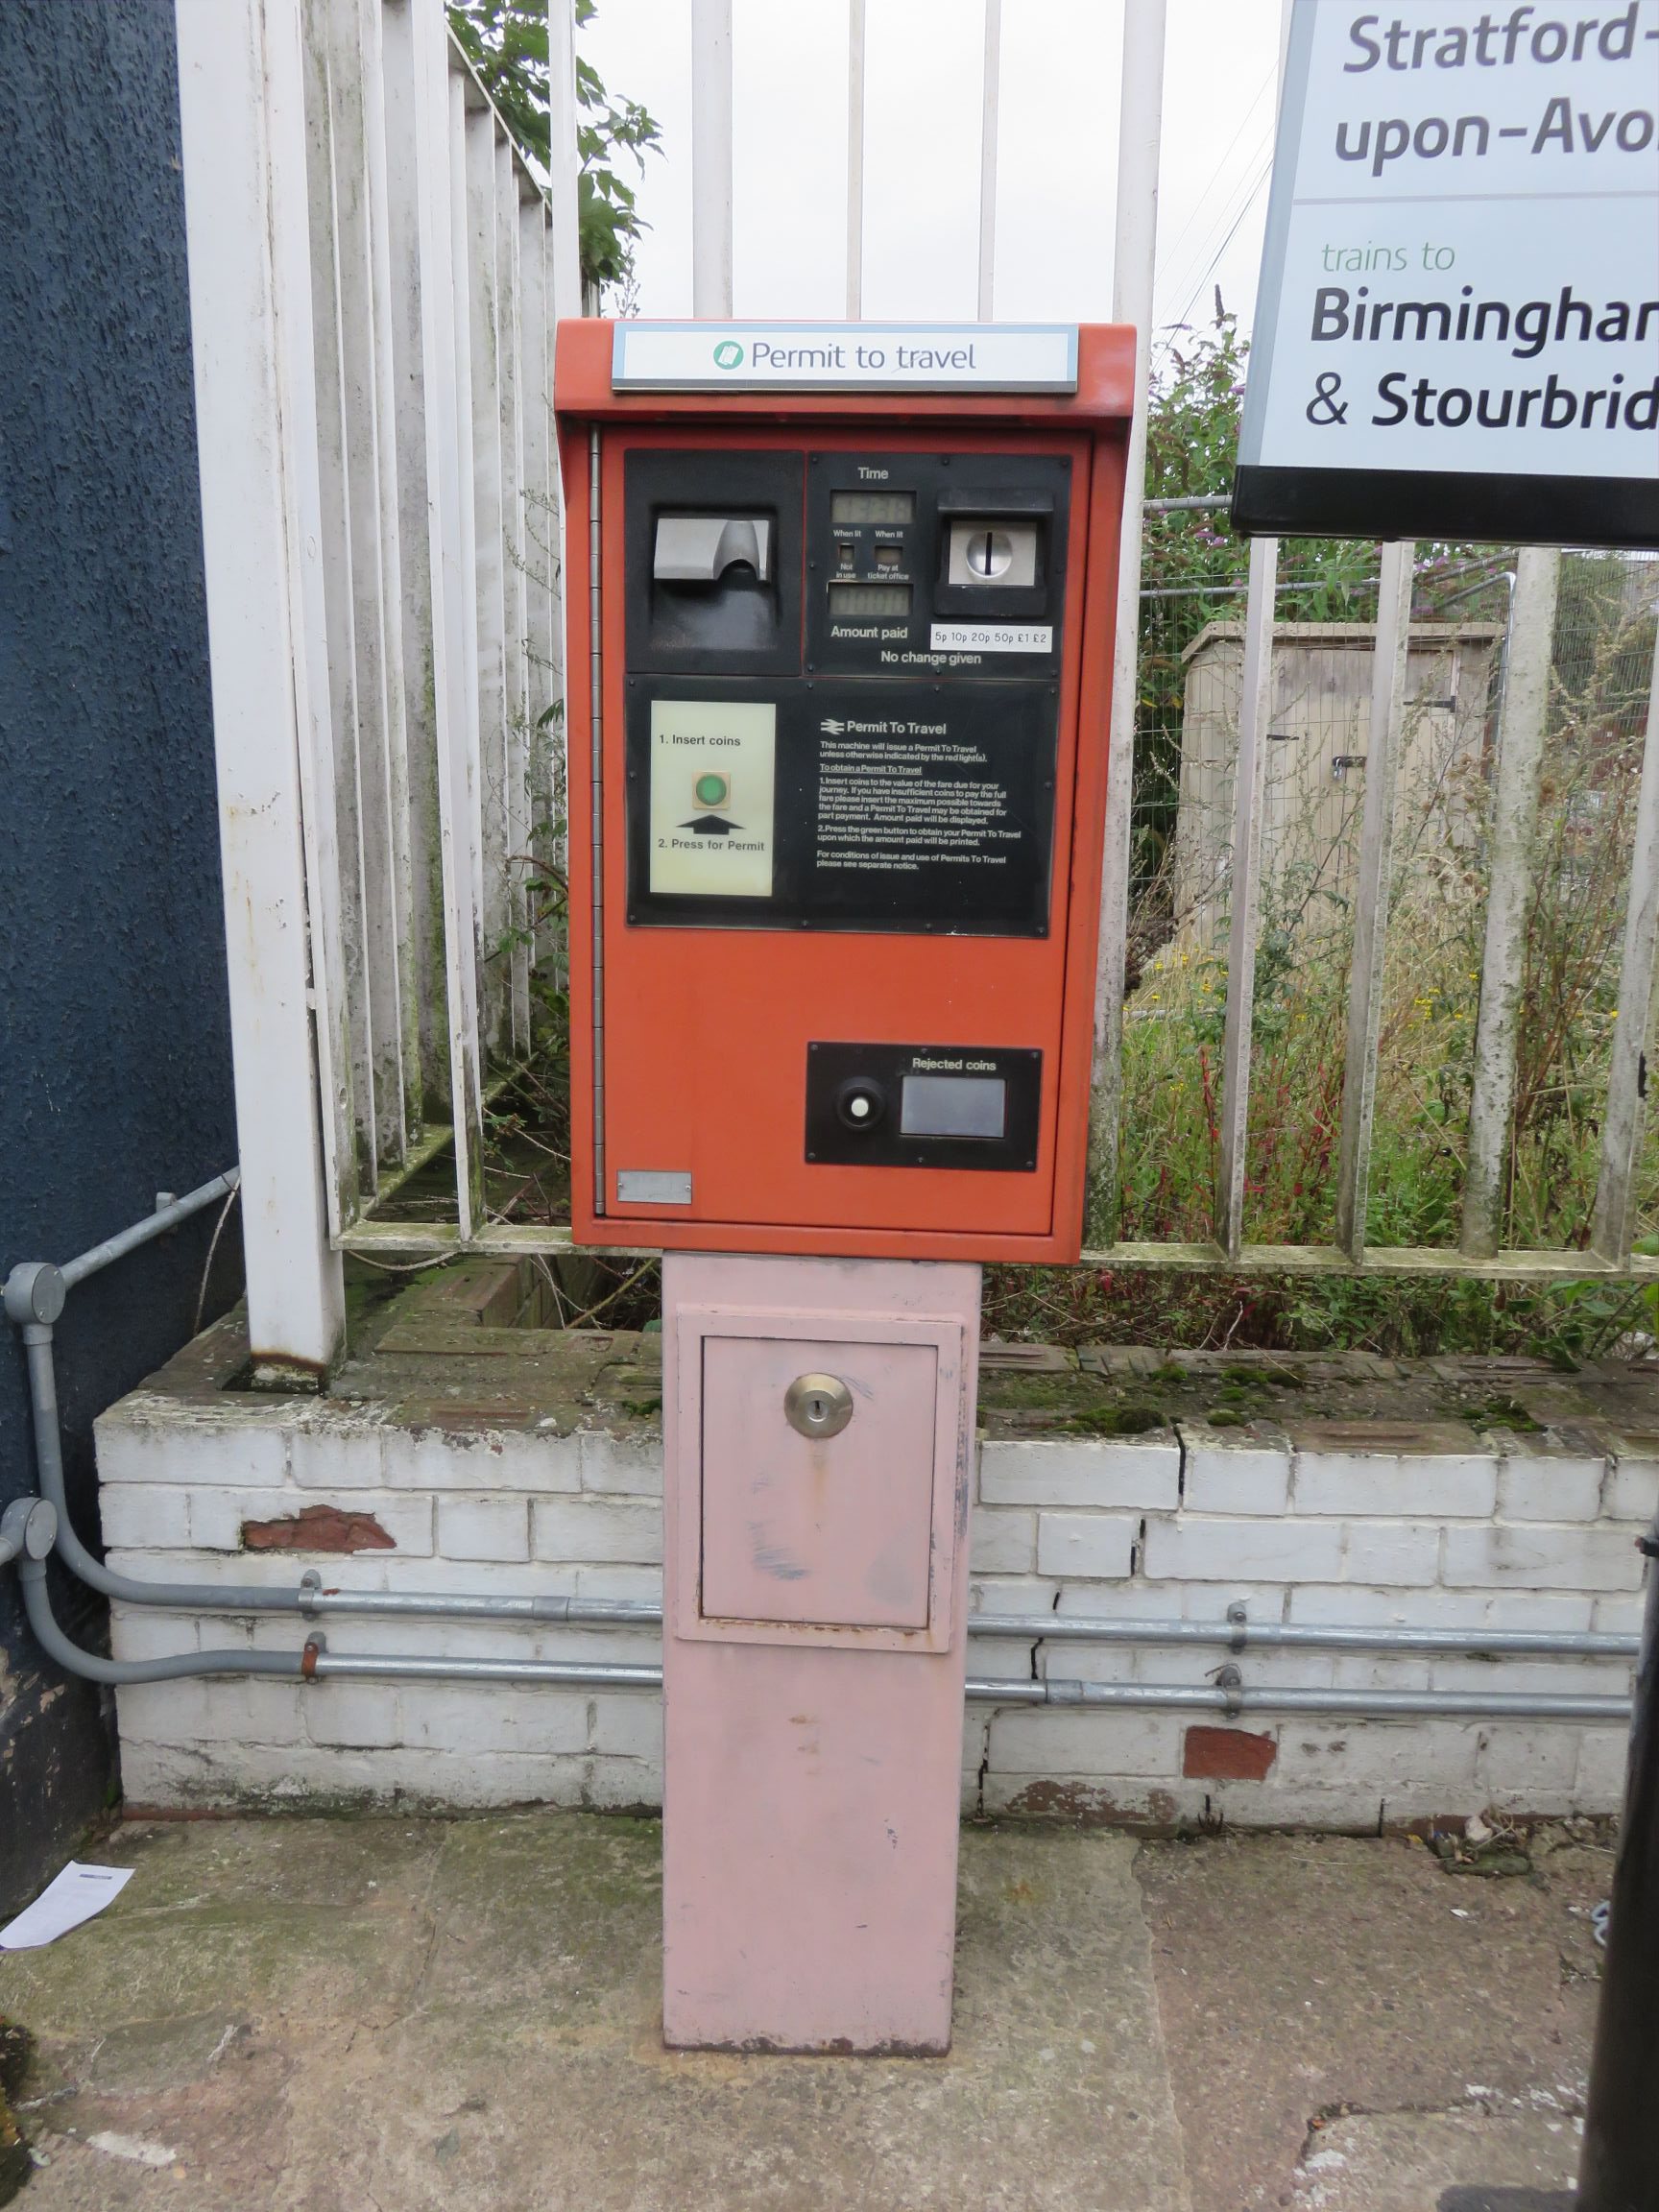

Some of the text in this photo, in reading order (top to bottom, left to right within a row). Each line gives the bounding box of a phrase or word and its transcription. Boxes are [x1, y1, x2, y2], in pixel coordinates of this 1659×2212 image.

[1335, 97, 1659, 178] upon-Avo
[1321, 240, 1455, 272] trains to
[752, 342, 976, 370] Permit to travel
[1306, 372, 1349, 425] &
[857, 467, 889, 480] Time
[832, 529, 854, 538] When
[875, 530, 895, 539] When
[878, 564, 890, 572] Pay
[888, 572, 909, 581] office
[830, 626, 908, 640] Amount paid
[935, 631, 1046, 643] 5p 10p 20p 50p £1 £2
[880, 651, 982, 667] No change given
[847, 720, 947, 734] Permit To Travel
[660, 734, 741, 747] 1. Insert coins
[872, 742, 885, 751] will
[845, 751, 884, 759] otherwise
[921, 753, 930, 761] by
[959, 755, 987, 763] light(s).
[861, 764, 886, 773] Permit
[887, 765, 898, 774] To
[819, 786, 850, 795] journey.
[891, 787, 934, 796] insufficient
[834, 795, 861, 804] please
[936, 798, 970, 806] possible
[970, 799, 1001, 807] towards
[907, 805, 931, 814] Travel
[931, 807, 949, 816] may
[960, 807, 995, 816] obtained
[818, 812, 834, 821] part
[835, 813, 871, 822] payment.
[873, 813, 903, 822] Amount
[905, 814, 922, 823] paid
[950, 816, 989, 825] displayed.
[847, 825, 860, 833] the
[918, 827, 943, 835] obtain
[943, 829, 960, 837] your
[961, 829, 987, 837] Permit
[987, 830, 998, 838] To
[998, 830, 1022, 838] Travel
[658, 838, 765, 852] 2. Press for Permit
[830, 851, 870, 859] conditions
[940, 854, 971, 862] Permits
[971, 854, 981, 863] To
[816, 859, 842, 868] please
[858, 860, 892, 869] separate
[912, 1057, 997, 1071] Rejected coins
